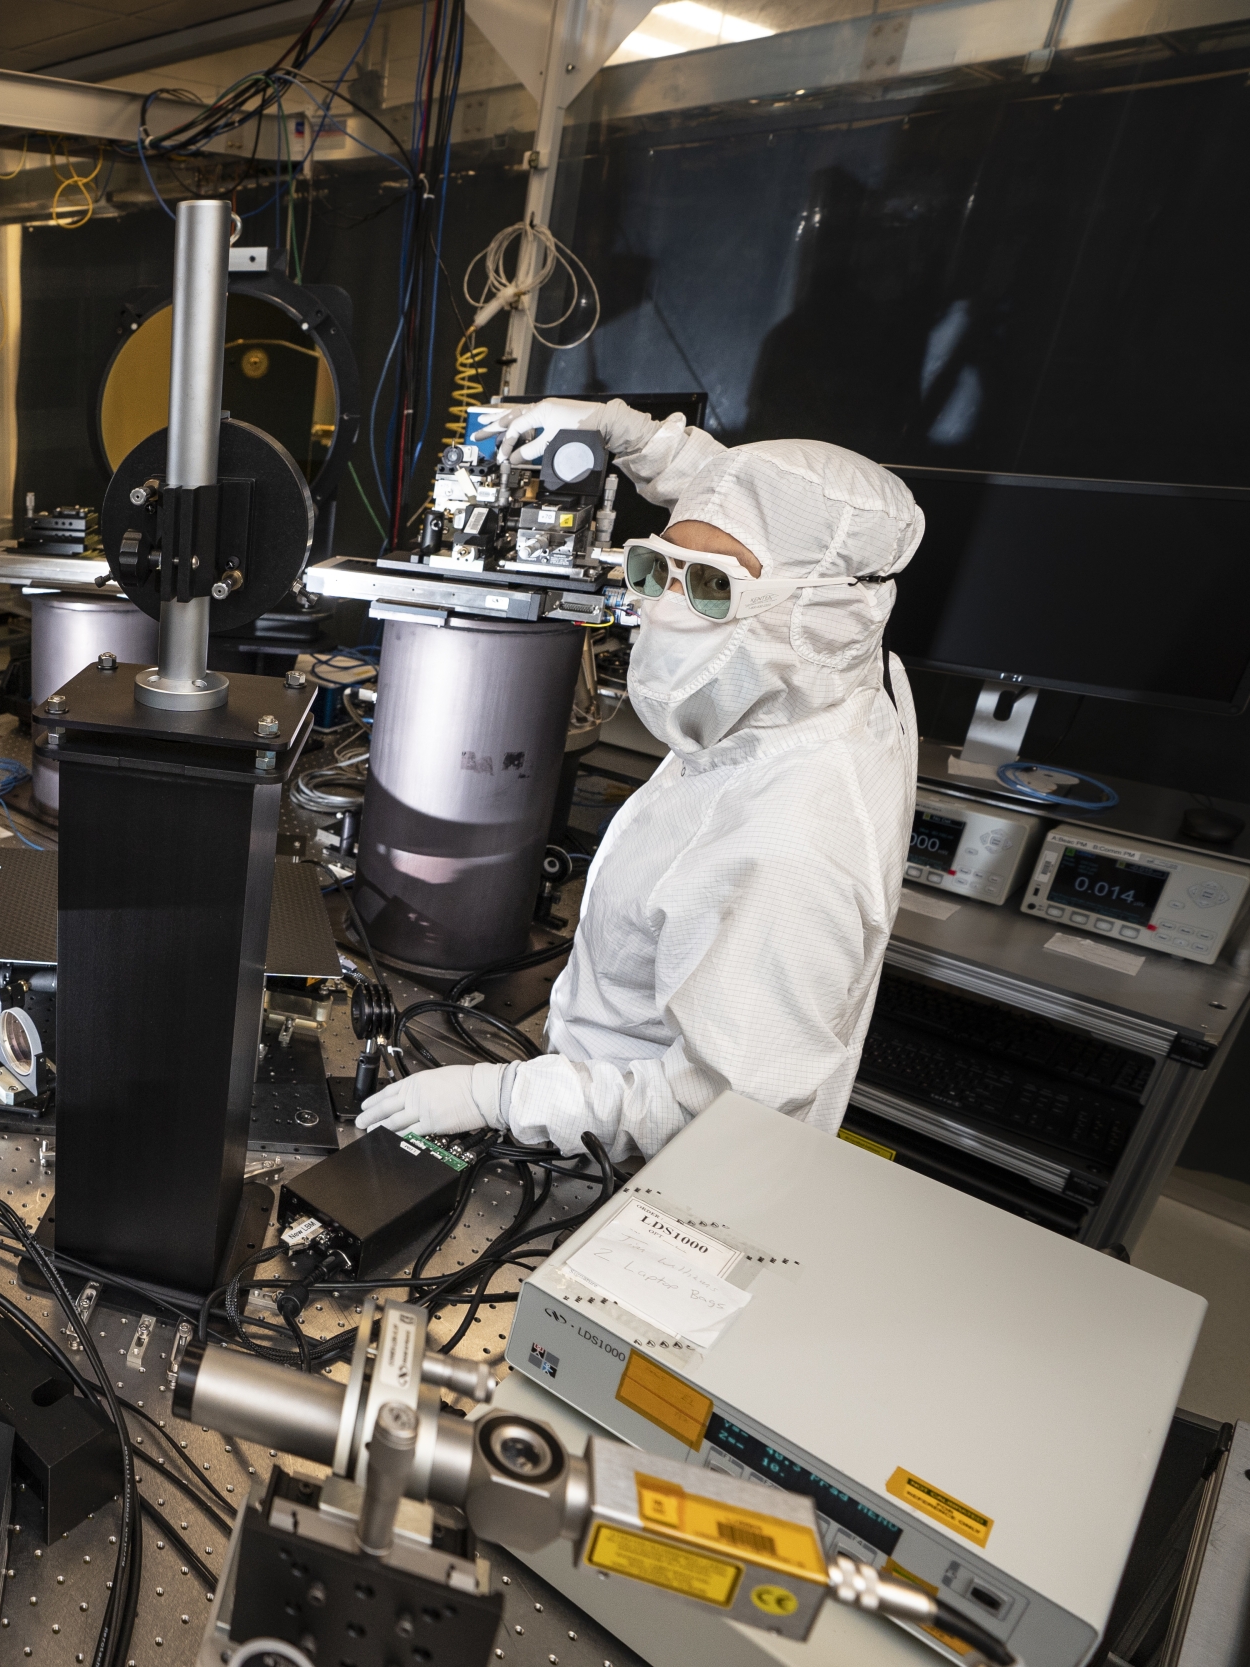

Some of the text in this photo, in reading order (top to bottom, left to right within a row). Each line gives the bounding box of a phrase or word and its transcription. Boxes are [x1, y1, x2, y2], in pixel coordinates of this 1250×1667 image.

[1074, 876, 1136, 904] 0.014
[287, 1229, 304, 1240] New
[639, 1215, 709, 1255] LDS1000
[623, 1261, 680, 1292] Laptop
[577, 1326, 627, 1363] LDS1000
